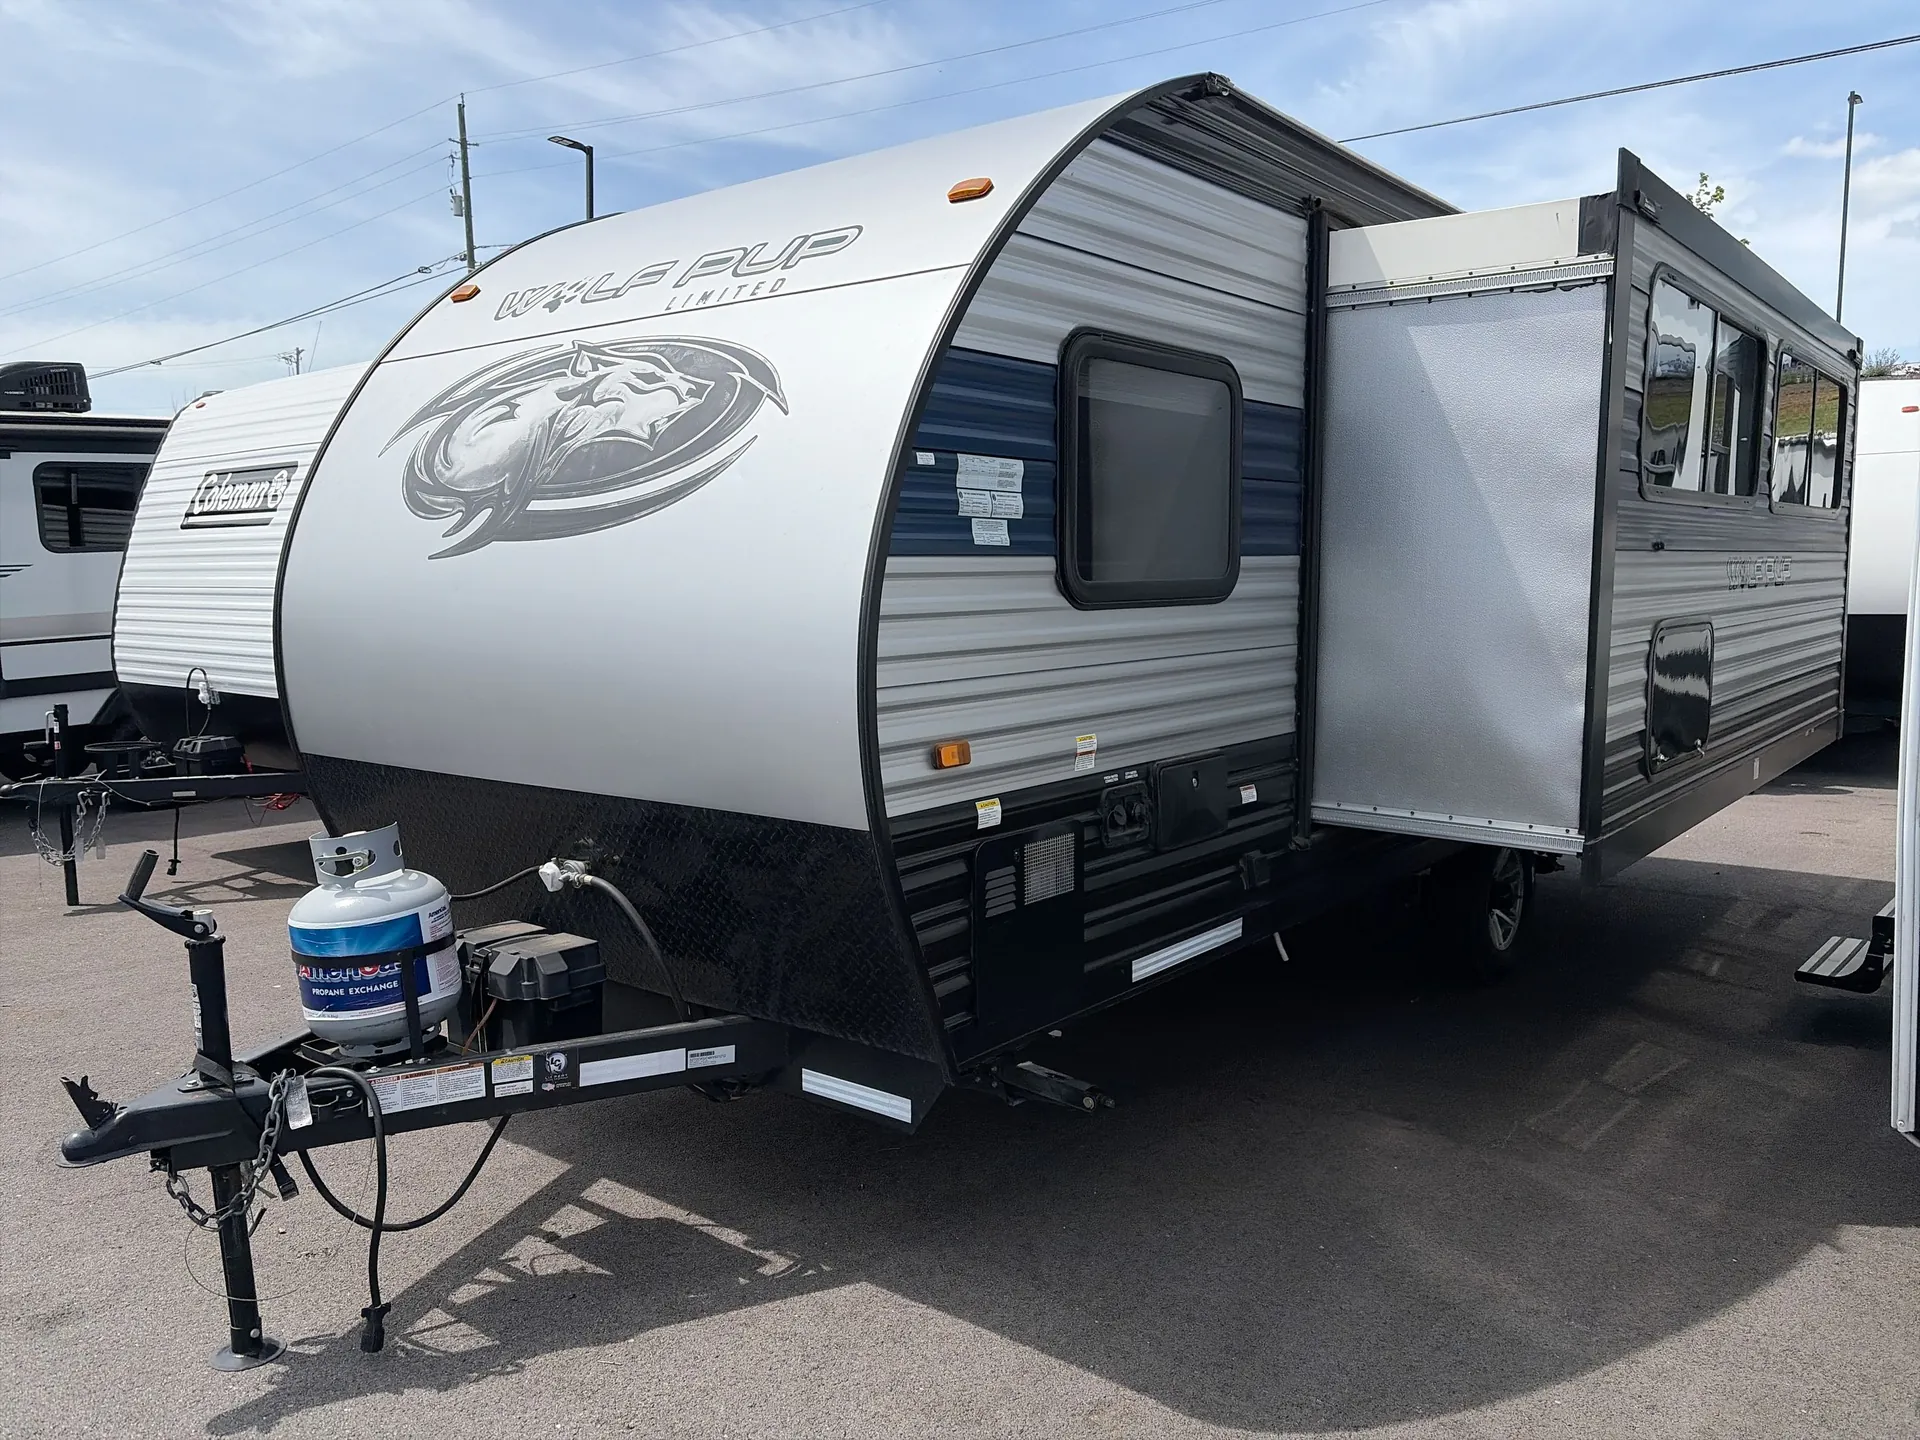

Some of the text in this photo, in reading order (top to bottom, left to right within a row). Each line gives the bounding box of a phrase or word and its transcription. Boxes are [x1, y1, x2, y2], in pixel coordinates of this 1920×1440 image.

[672, 224, 864, 289] PUP
[665, 277, 786, 311] LIMITED
[193, 473, 270, 514] Coleman
[312, 980, 399, 996] PROPANE EXCHANGE
